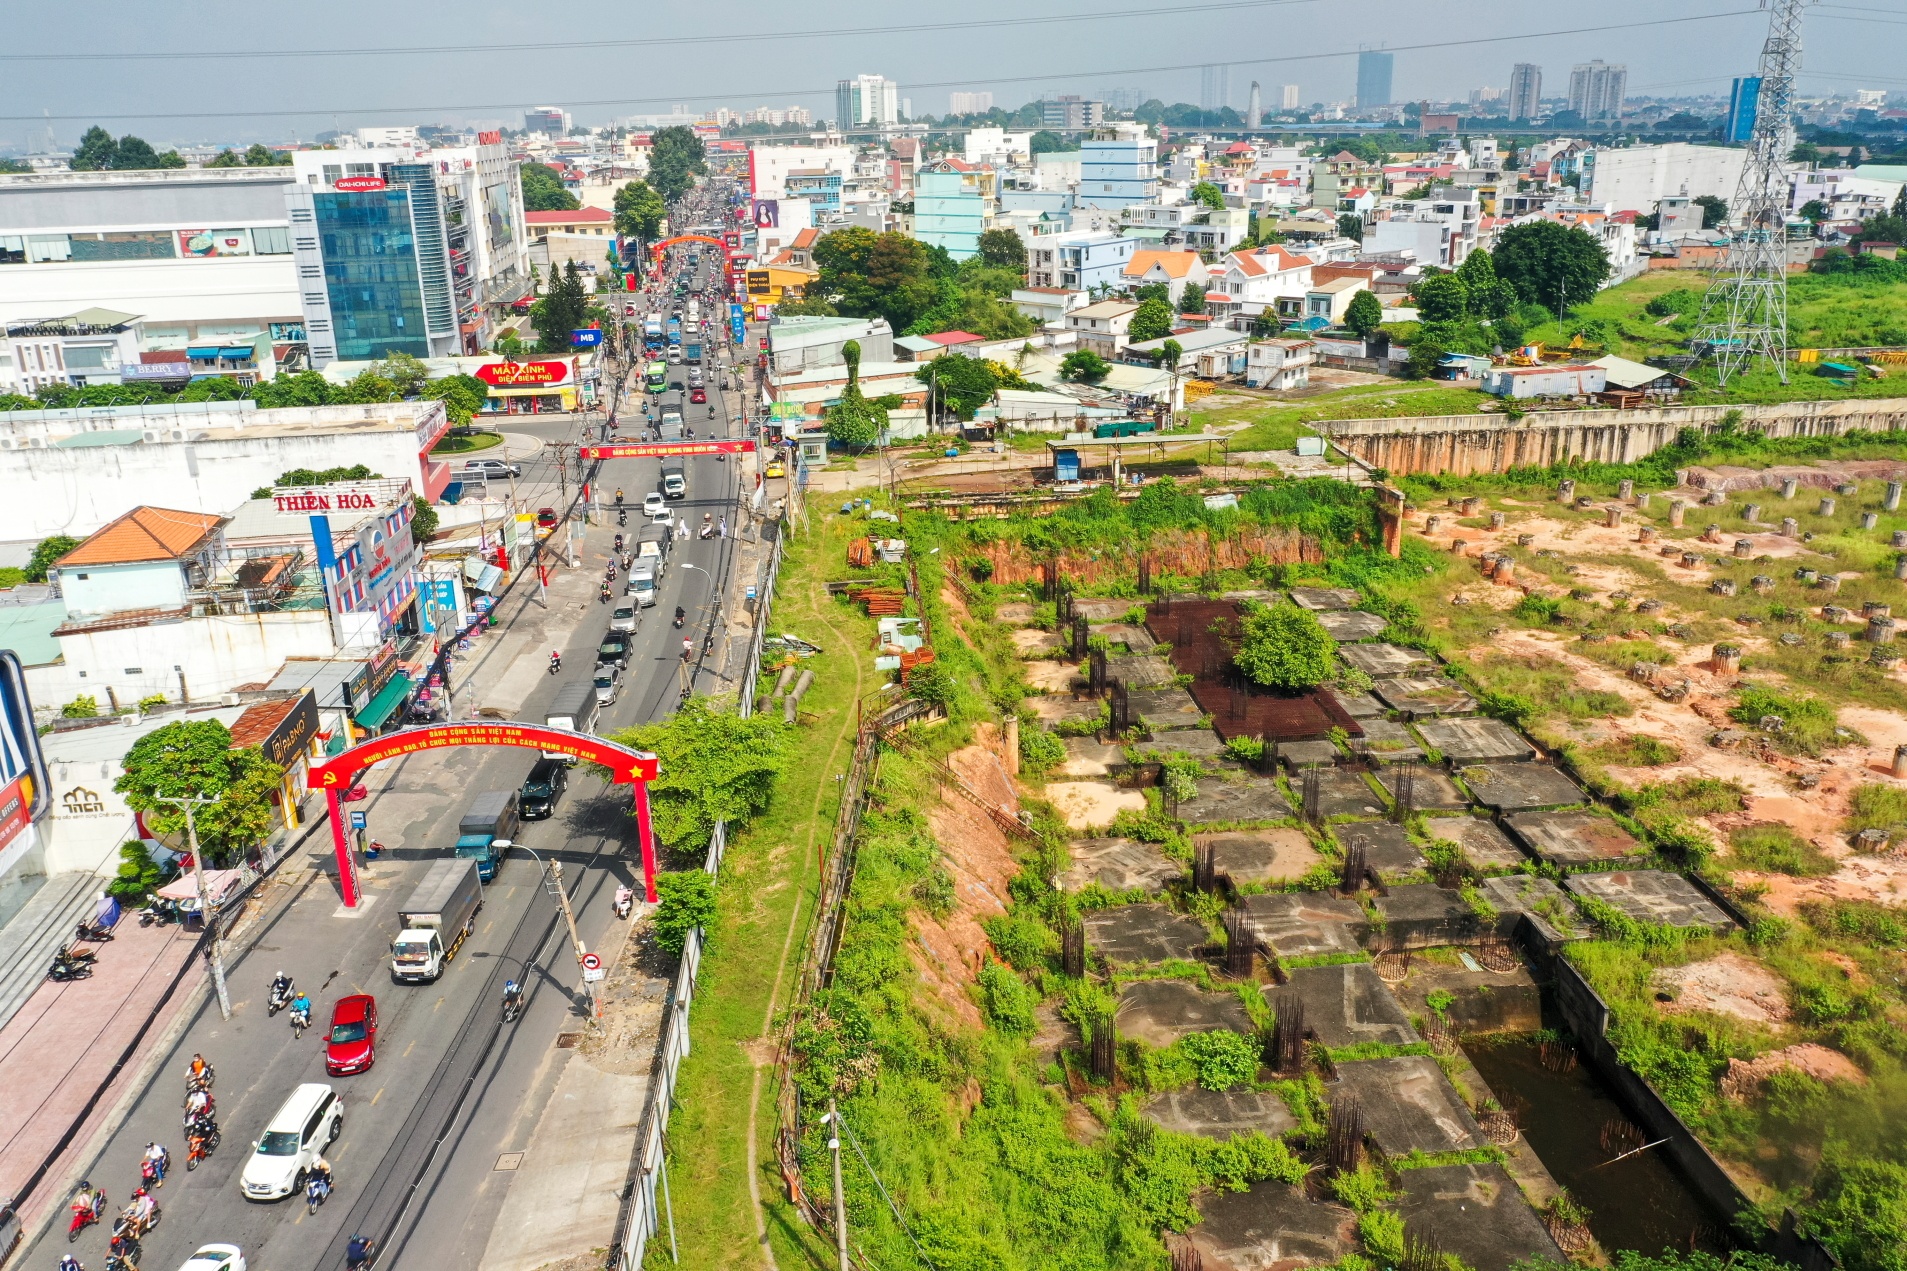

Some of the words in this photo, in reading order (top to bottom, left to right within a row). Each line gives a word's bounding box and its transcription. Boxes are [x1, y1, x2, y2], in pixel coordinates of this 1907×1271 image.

[580, 333, 595, 342] MB
[137, 364, 173, 374] BERRY
[517, 373, 535, 382] BIÊN
[537, 372, 553, 381] PHỦ
[273, 491, 331, 512] THIÊN
[336, 488, 376, 509] HÒA
[282, 718, 305, 753] PABNO
[429, 726, 448, 738] ĐẢNG
[450, 727, 468, 735] CỘNG
[470, 725, 486, 735] SẢN
[488, 726, 503, 735] VIỆT
[506, 728, 522, 736] NAM
[363, 750, 383, 764] NGƯỜI
[429, 737, 447, 746] CHỨC
[449, 737, 462, 746] MỌI
[464, 735, 486, 744] THẮNG
[489, 736, 500, 745] LỢI
[503, 735, 517, 745] CỦA
[519, 738, 538, 747] CÁCH
[540, 741, 561, 751] MẠNG
[563, 745, 579, 755] VIỆT
[580, 750, 597, 760] NAM
